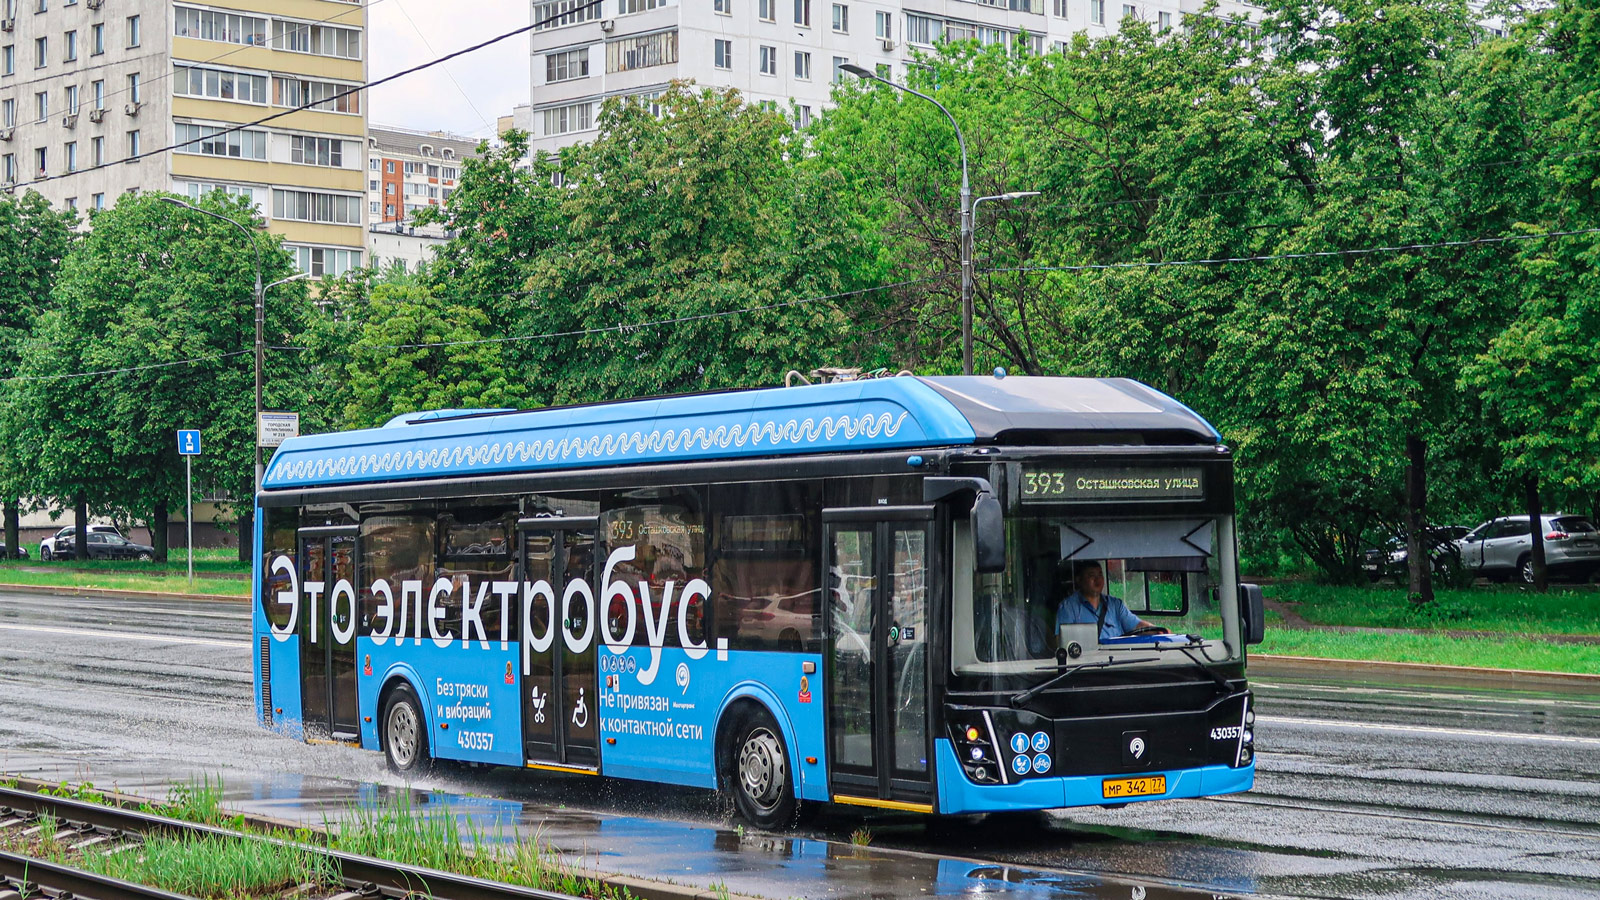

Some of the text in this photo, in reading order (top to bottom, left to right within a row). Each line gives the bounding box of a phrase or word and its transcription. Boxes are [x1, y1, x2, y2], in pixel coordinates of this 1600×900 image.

[1024, 472, 1199, 495] 393 Осташковская улица
[612, 520, 633, 540] 393
[638, 524, 686, 535] Осташковская
[270, 555, 356, 644] Это
[436, 677, 488, 702] Без тряски
[437, 702, 492, 722] и вибраций
[600, 688, 670, 714] Не привязан
[600, 717, 703, 741] к контактной сети
[1210, 726, 1242, 740] 430357
[457, 730, 494, 751] 430357
[1126, 780, 1146, 794] 342
[1152, 778, 1162, 788] 77
